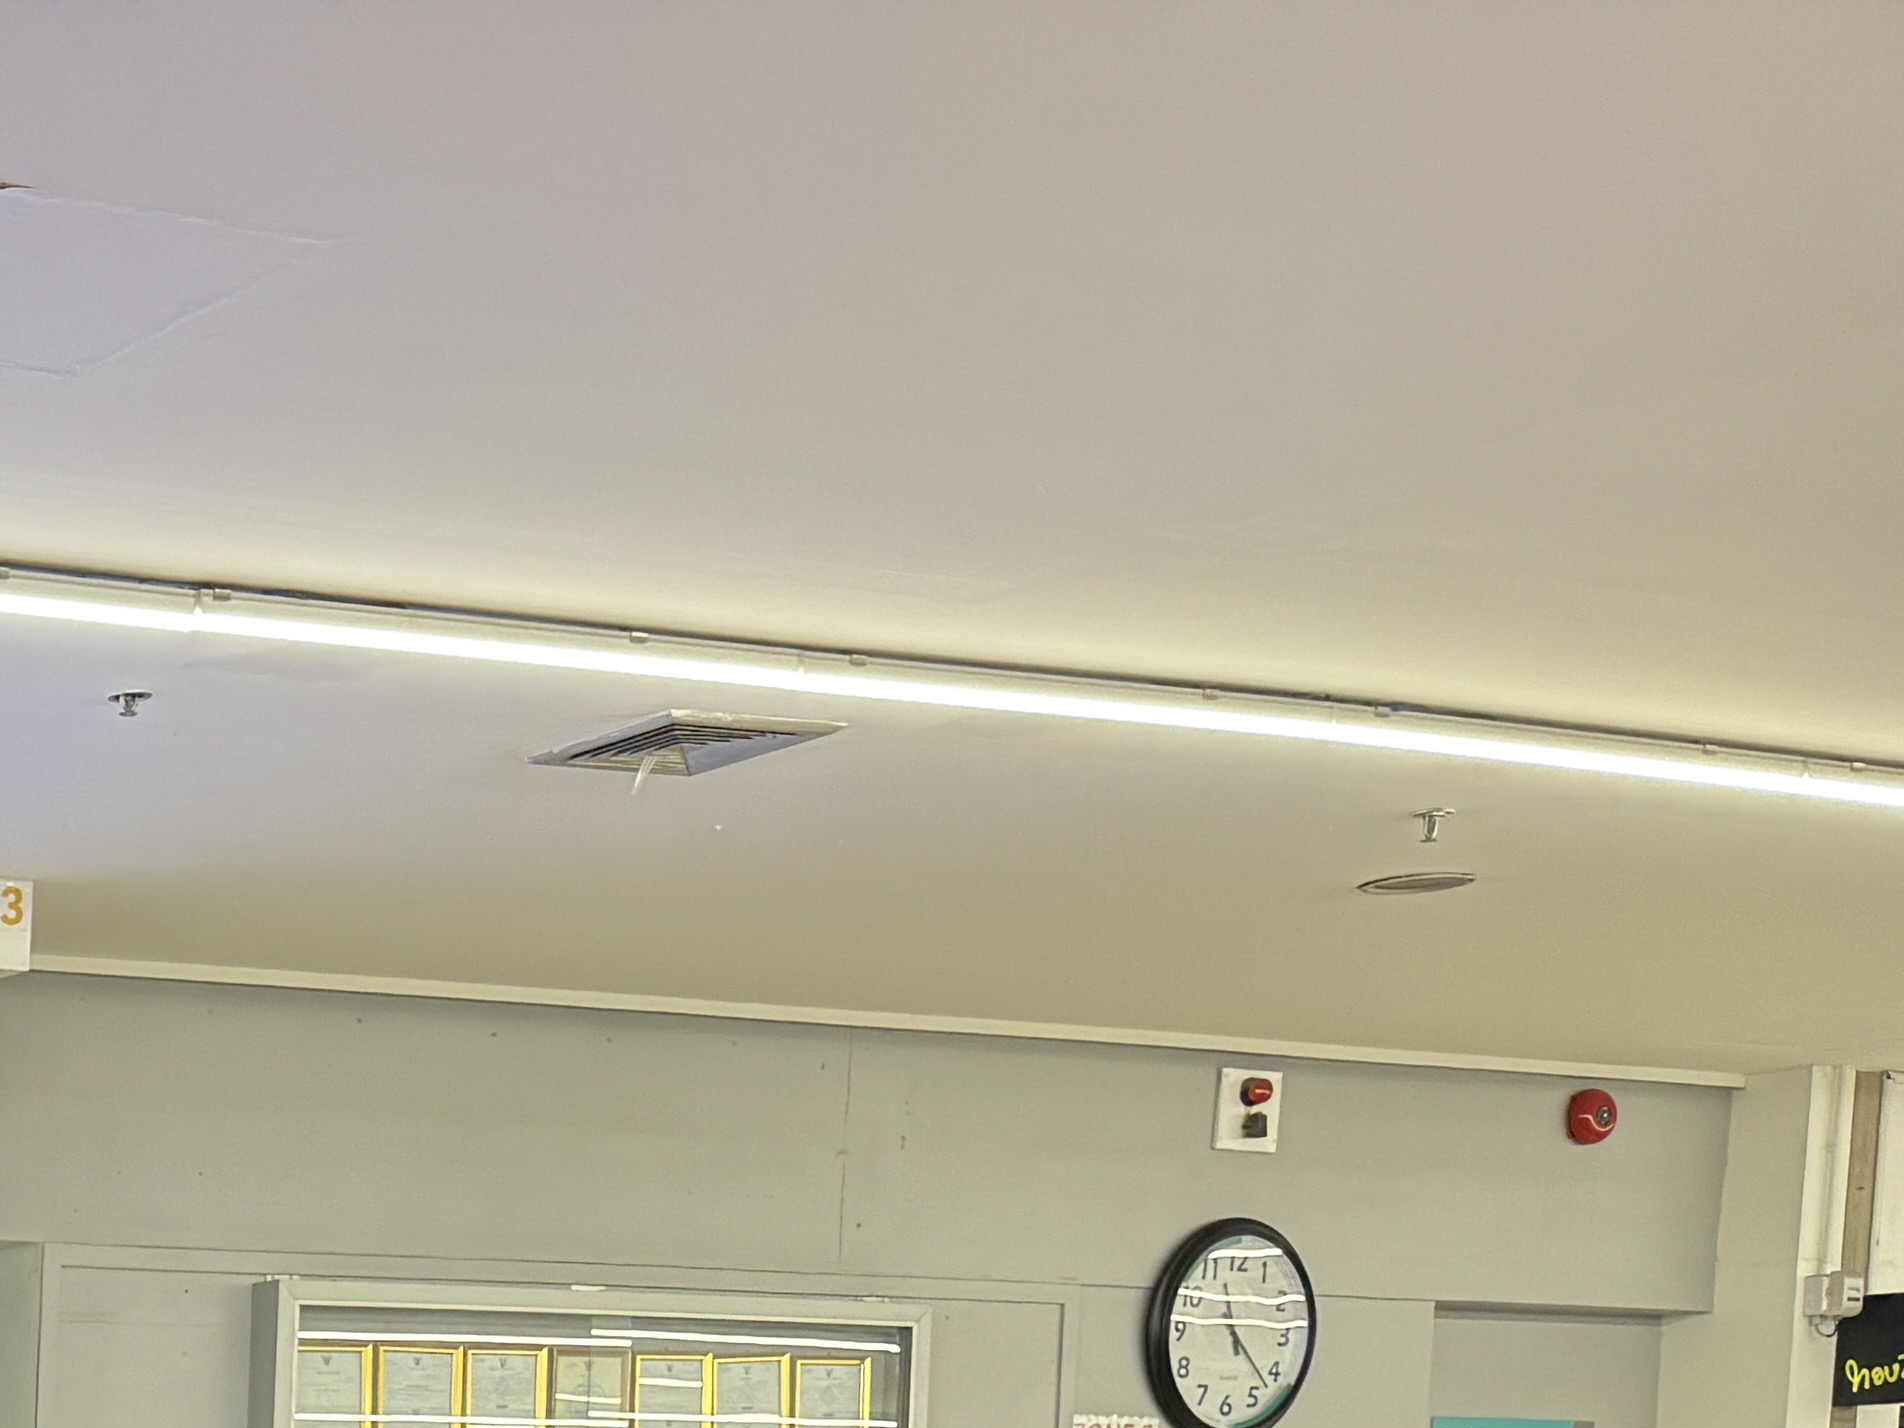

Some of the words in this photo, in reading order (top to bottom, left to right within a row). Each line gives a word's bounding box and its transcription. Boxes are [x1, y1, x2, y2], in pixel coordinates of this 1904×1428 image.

[1176, 1356, 1191, 1379] 8
[1267, 1361, 1281, 1383] 4
[1196, 1383, 1209, 1407] 7
[1219, 1394, 1233, 1416] 6
[1245, 1385, 1260, 1409] 5
